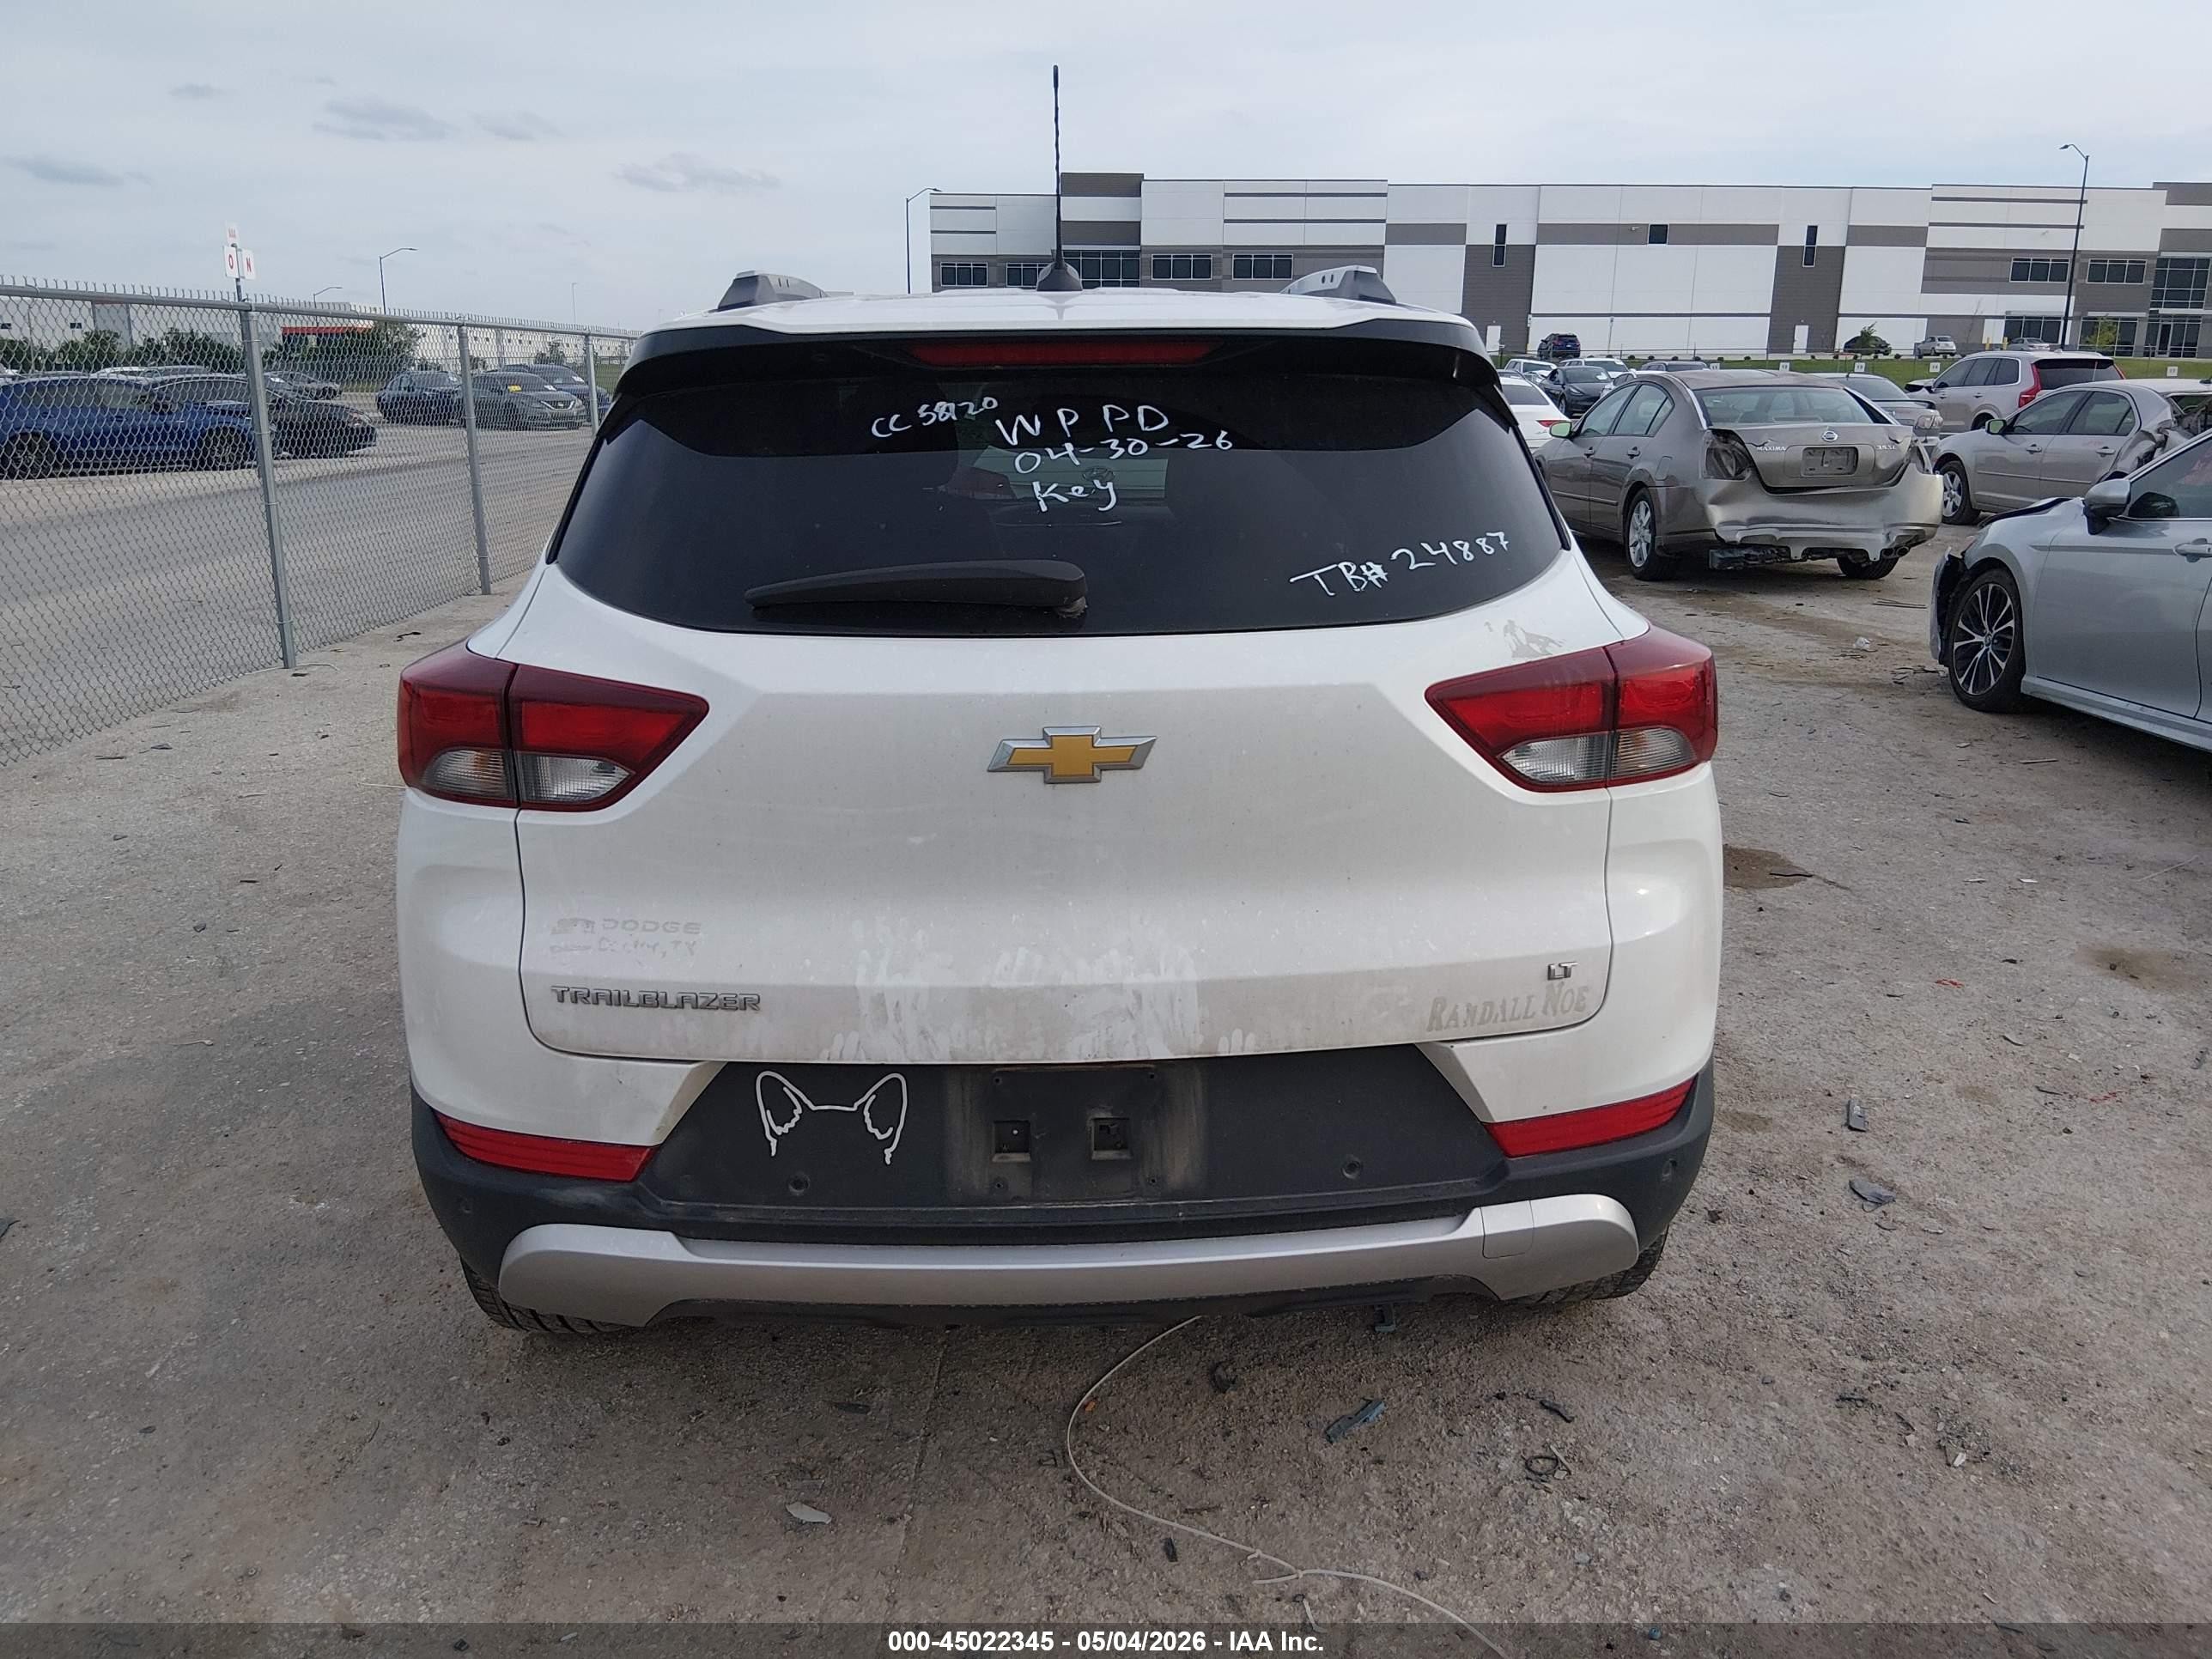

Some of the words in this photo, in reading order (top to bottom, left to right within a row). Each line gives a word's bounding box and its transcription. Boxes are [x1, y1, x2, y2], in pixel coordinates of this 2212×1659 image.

[871, 414, 913, 438] CC
[602, 918, 702, 935] DODGE
[1547, 961, 1578, 981] LT
[550, 985, 761, 1012] TRAILBLAZER
